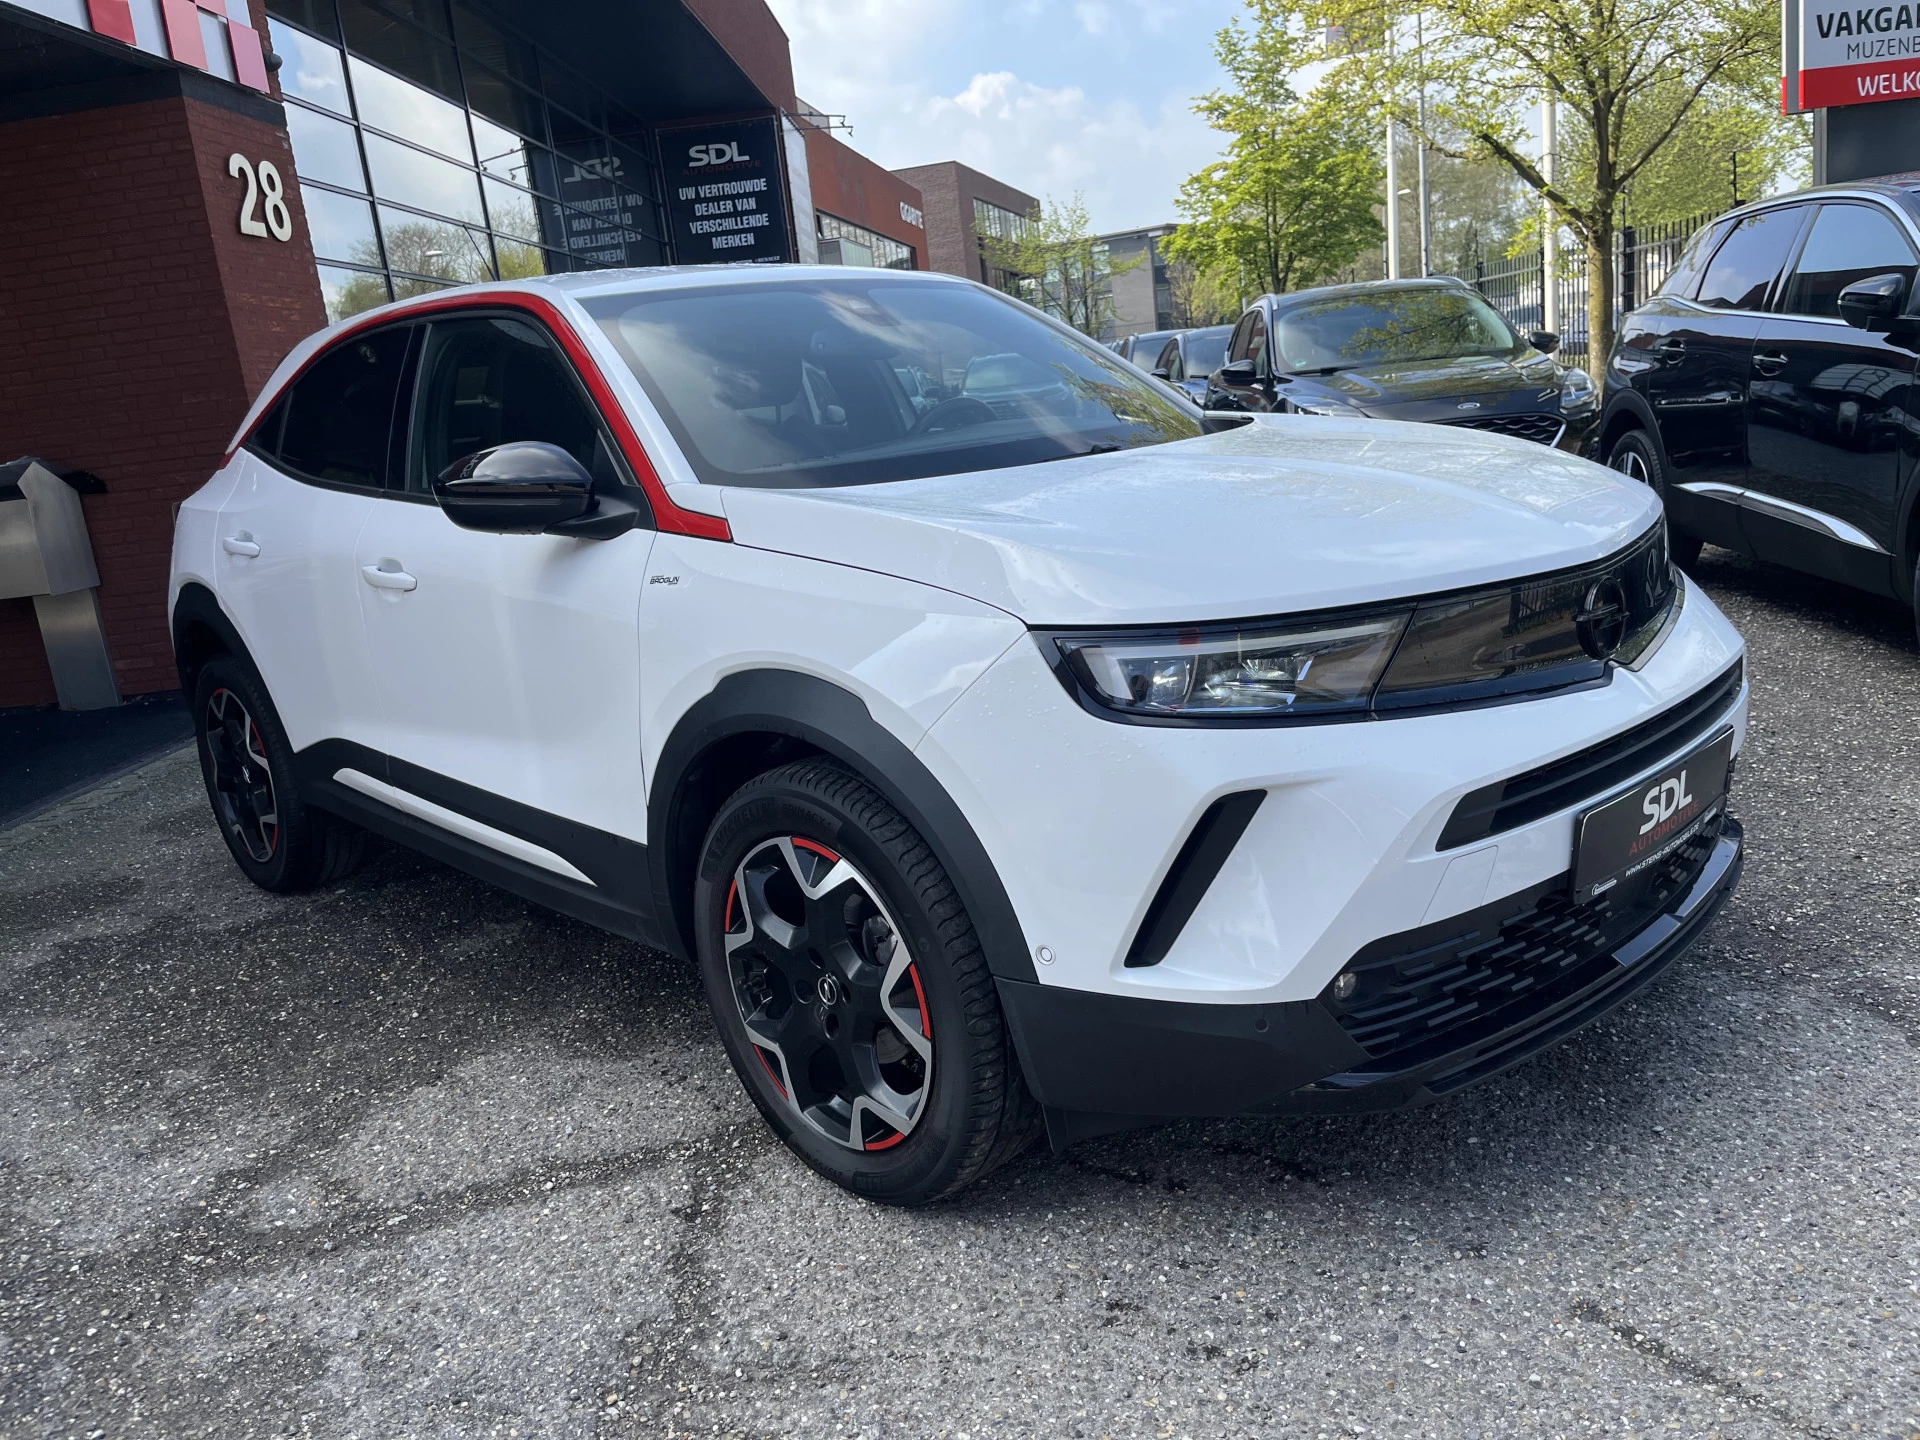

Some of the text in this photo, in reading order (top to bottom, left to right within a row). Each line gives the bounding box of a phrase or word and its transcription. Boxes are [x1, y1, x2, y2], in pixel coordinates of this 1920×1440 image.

[1816, 3, 1920, 39] VAKGA
[688, 141, 750, 167] SDL
[682, 160, 760, 176] AUTOMOTIVE
[229, 153, 292, 242] 28
[679, 178, 767, 200] UW VERTROUWDE
[694, 197, 756, 216] DEALER VAN
[689, 213, 769, 235] VERSCHILLENDE
[711, 232, 755, 250] MERKEN
[1639, 769, 1692, 836] SDL
[1629, 800, 1699, 857] AUTOMOTIVE
